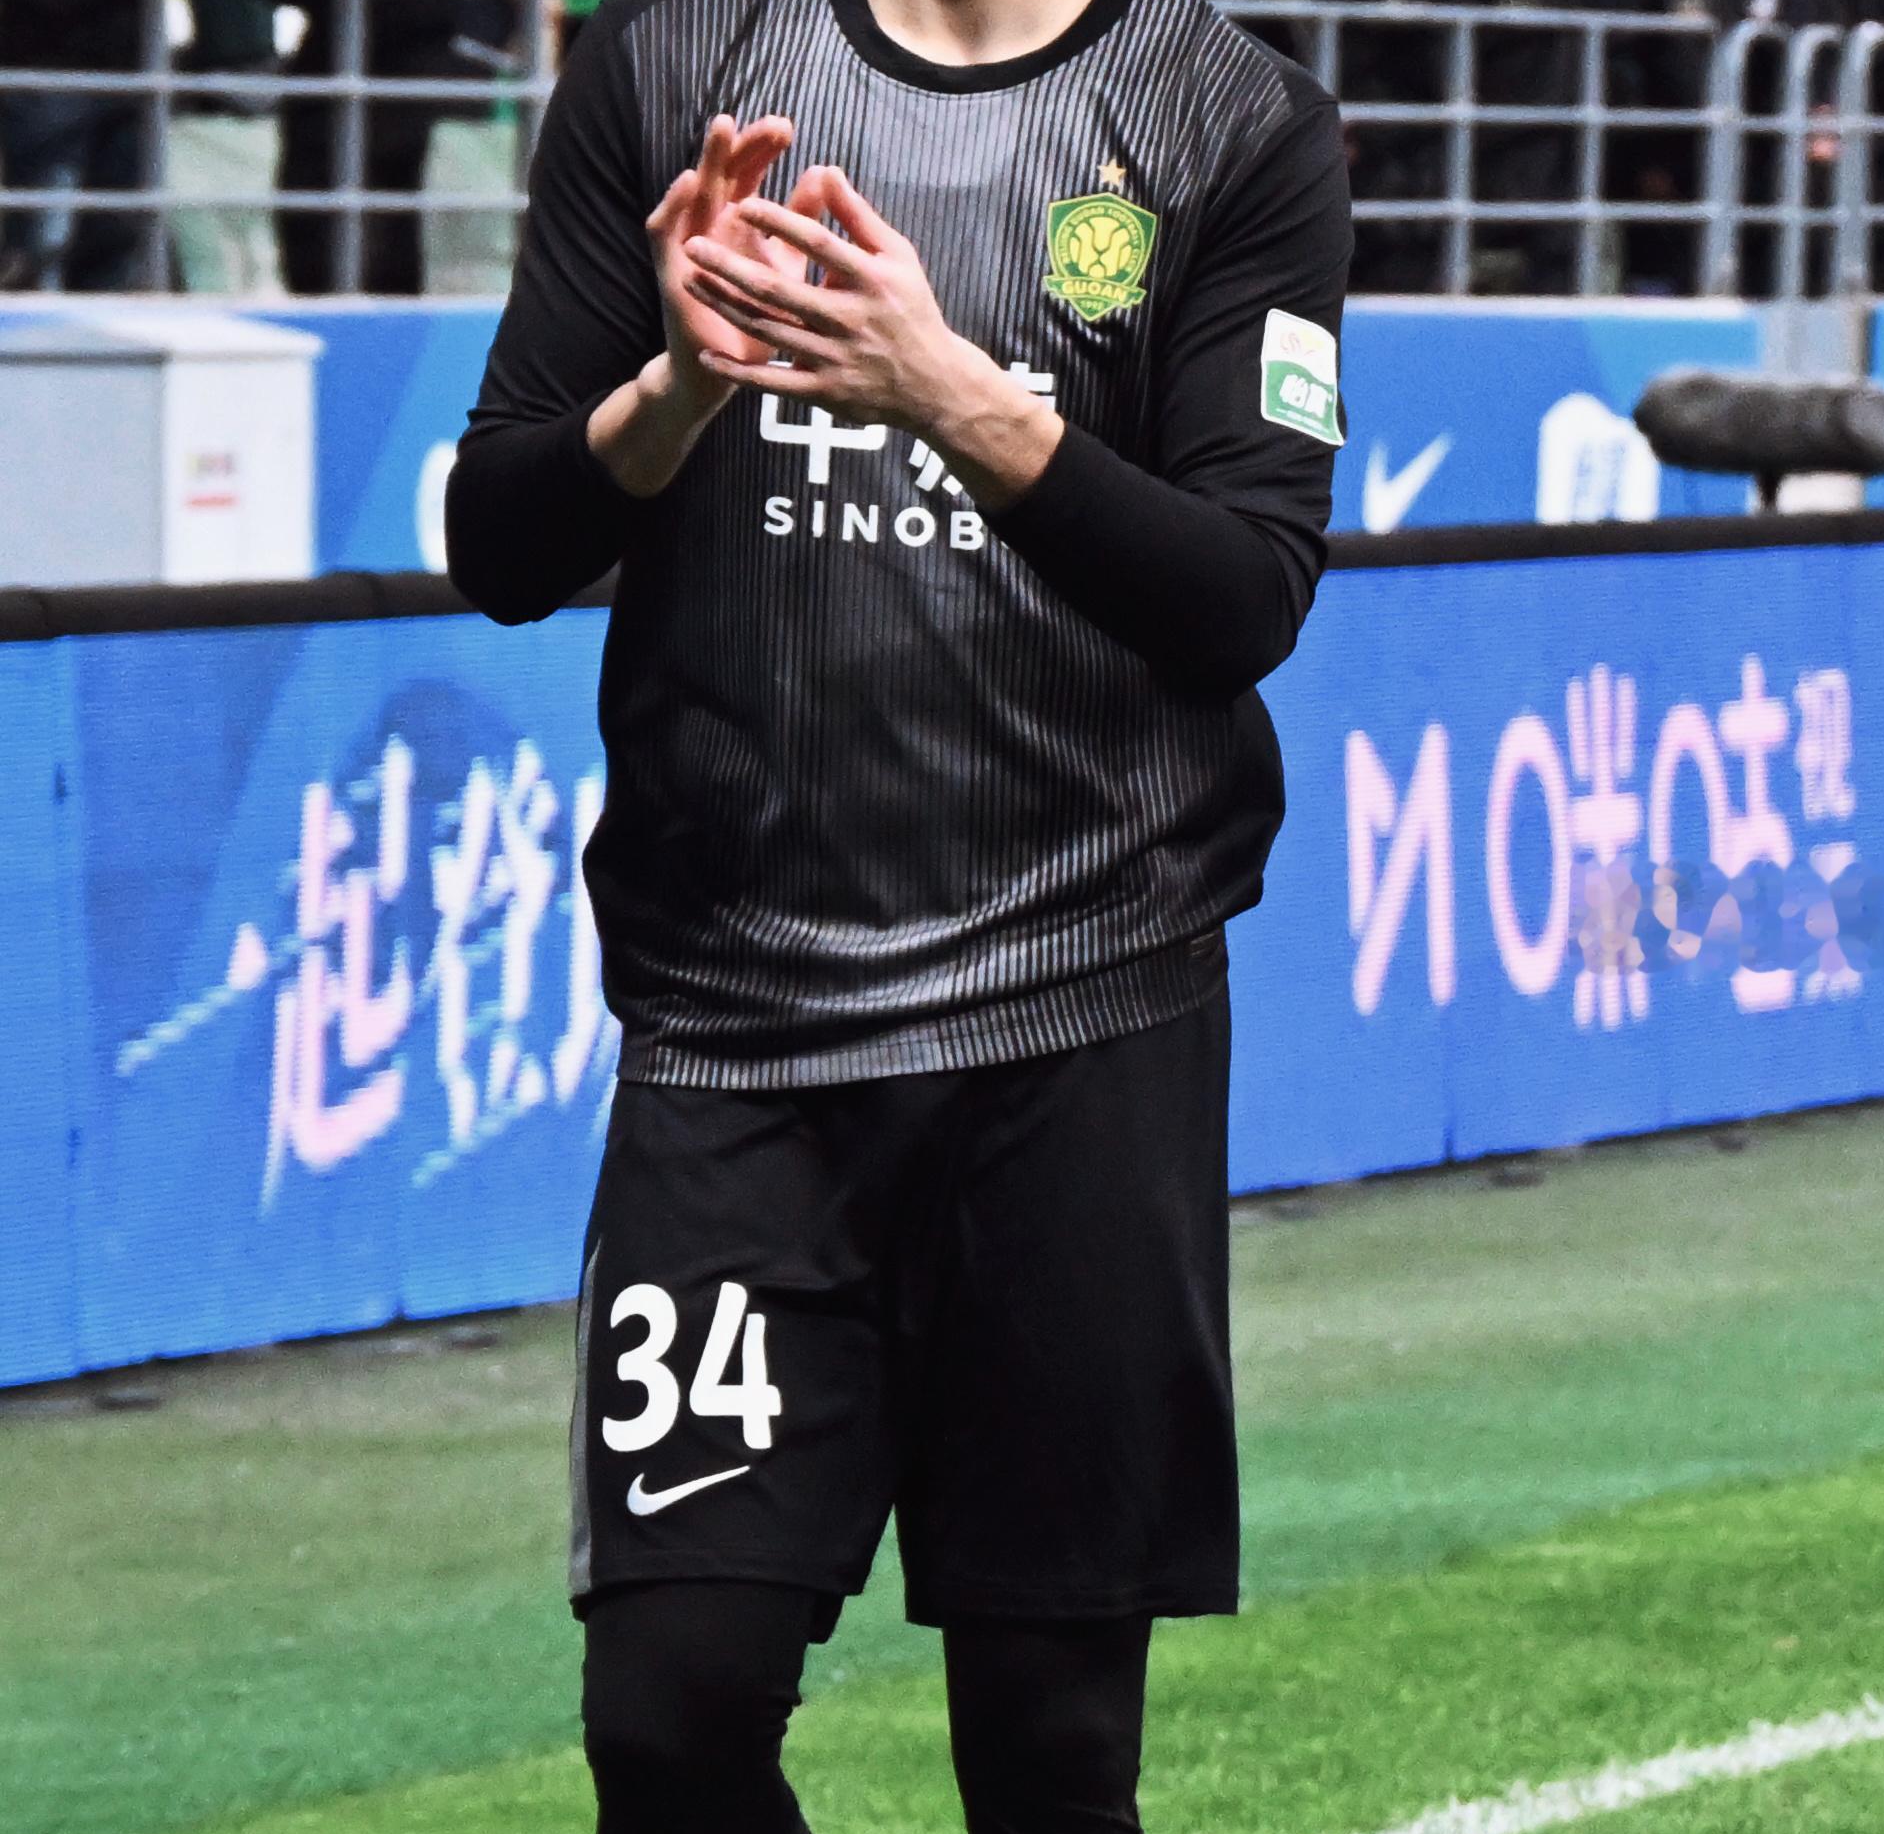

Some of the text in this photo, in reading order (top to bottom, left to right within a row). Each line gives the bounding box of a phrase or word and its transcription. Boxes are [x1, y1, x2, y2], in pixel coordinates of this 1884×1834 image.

[1062, 279, 1128, 302] GUOAN
[763, 496, 1009, 552] SINOB
[602, 1281, 782, 1452] 34
